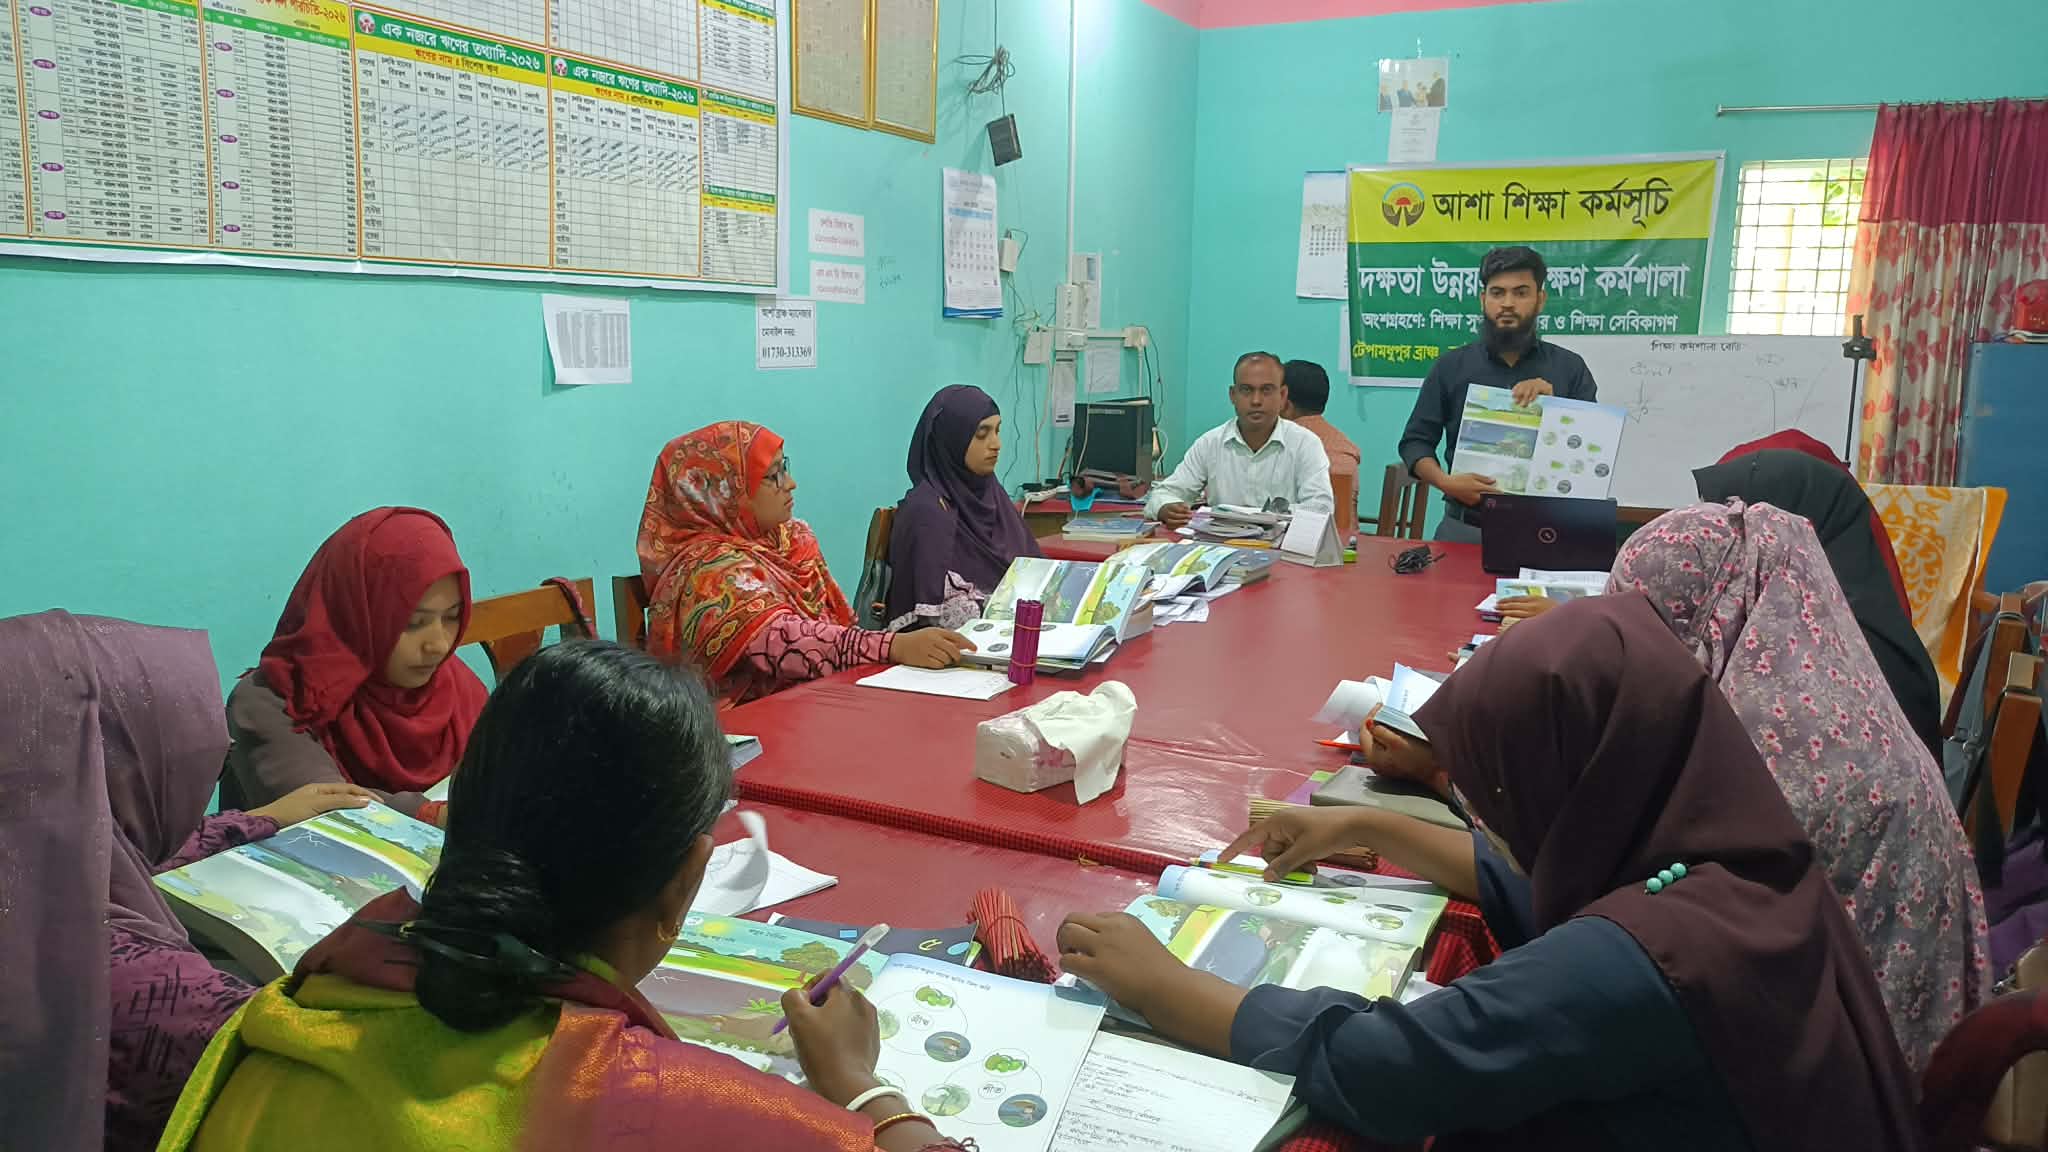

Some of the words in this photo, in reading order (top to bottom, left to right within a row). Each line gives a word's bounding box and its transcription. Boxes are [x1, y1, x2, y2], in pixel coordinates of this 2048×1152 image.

[381, 23, 402, 39] এক
[406, 27, 437, 48] নজরে
[440, 34, 470, 53] ঋণের
[1433, 191, 1495, 224] আশা
[1502, 181, 1571, 220] শিক্ষা
[1578, 177, 1674, 229] কর্মসূচি
[1359, 265, 1426, 297] দক্ষতা
[1430, 257, 1487, 303] উন্নয়
[1594, 253, 1690, 297] কর্মশালা
[1429, 308, 1462, 331] শিক্ষা
[1553, 314, 1566, 331] ও
[1570, 308, 1606, 332] শিক্ষা
[1608, 309, 1679, 333] সেবিকাগণ
[762, 345, 813, 359] 01730-313369
